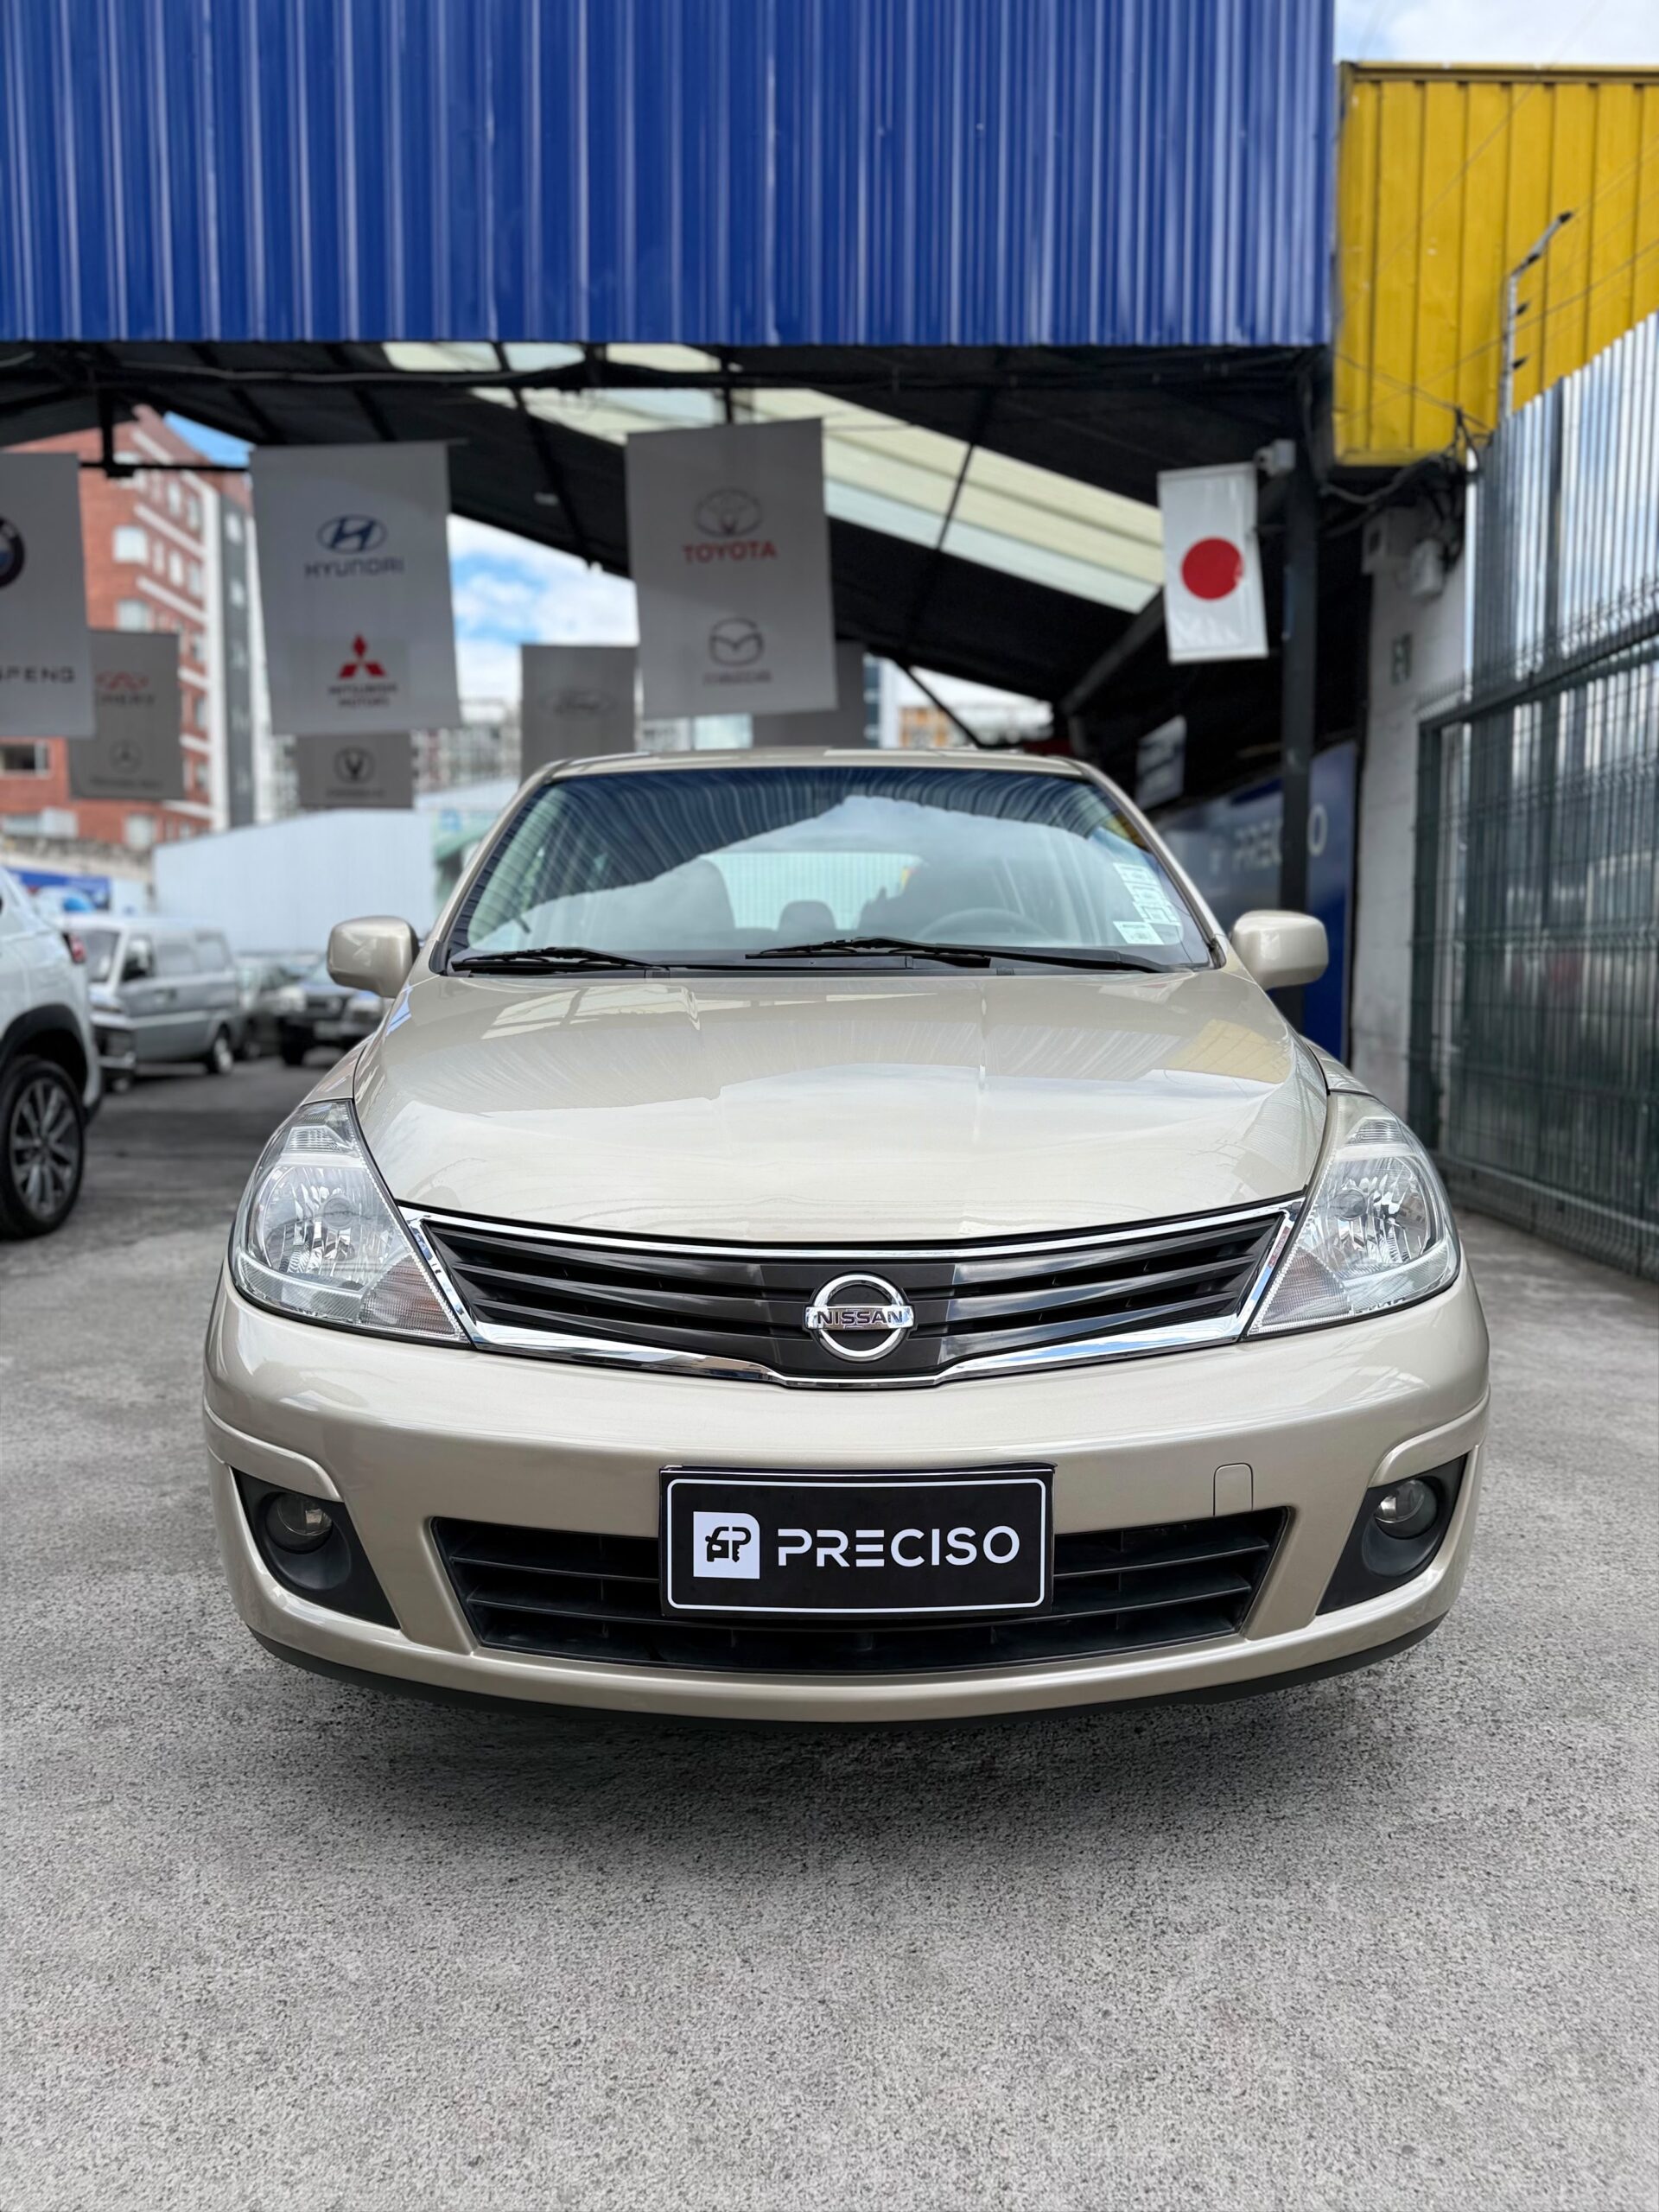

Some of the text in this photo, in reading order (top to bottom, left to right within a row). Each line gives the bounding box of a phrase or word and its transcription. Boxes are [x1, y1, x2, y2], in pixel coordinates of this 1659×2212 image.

[683, 540, 777, 563] TOYOTA
[304, 557, 404, 578] HYUNDAI
[817, 1310, 903, 1325] NISSAN
[777, 1526, 1020, 1567] PRECISO
